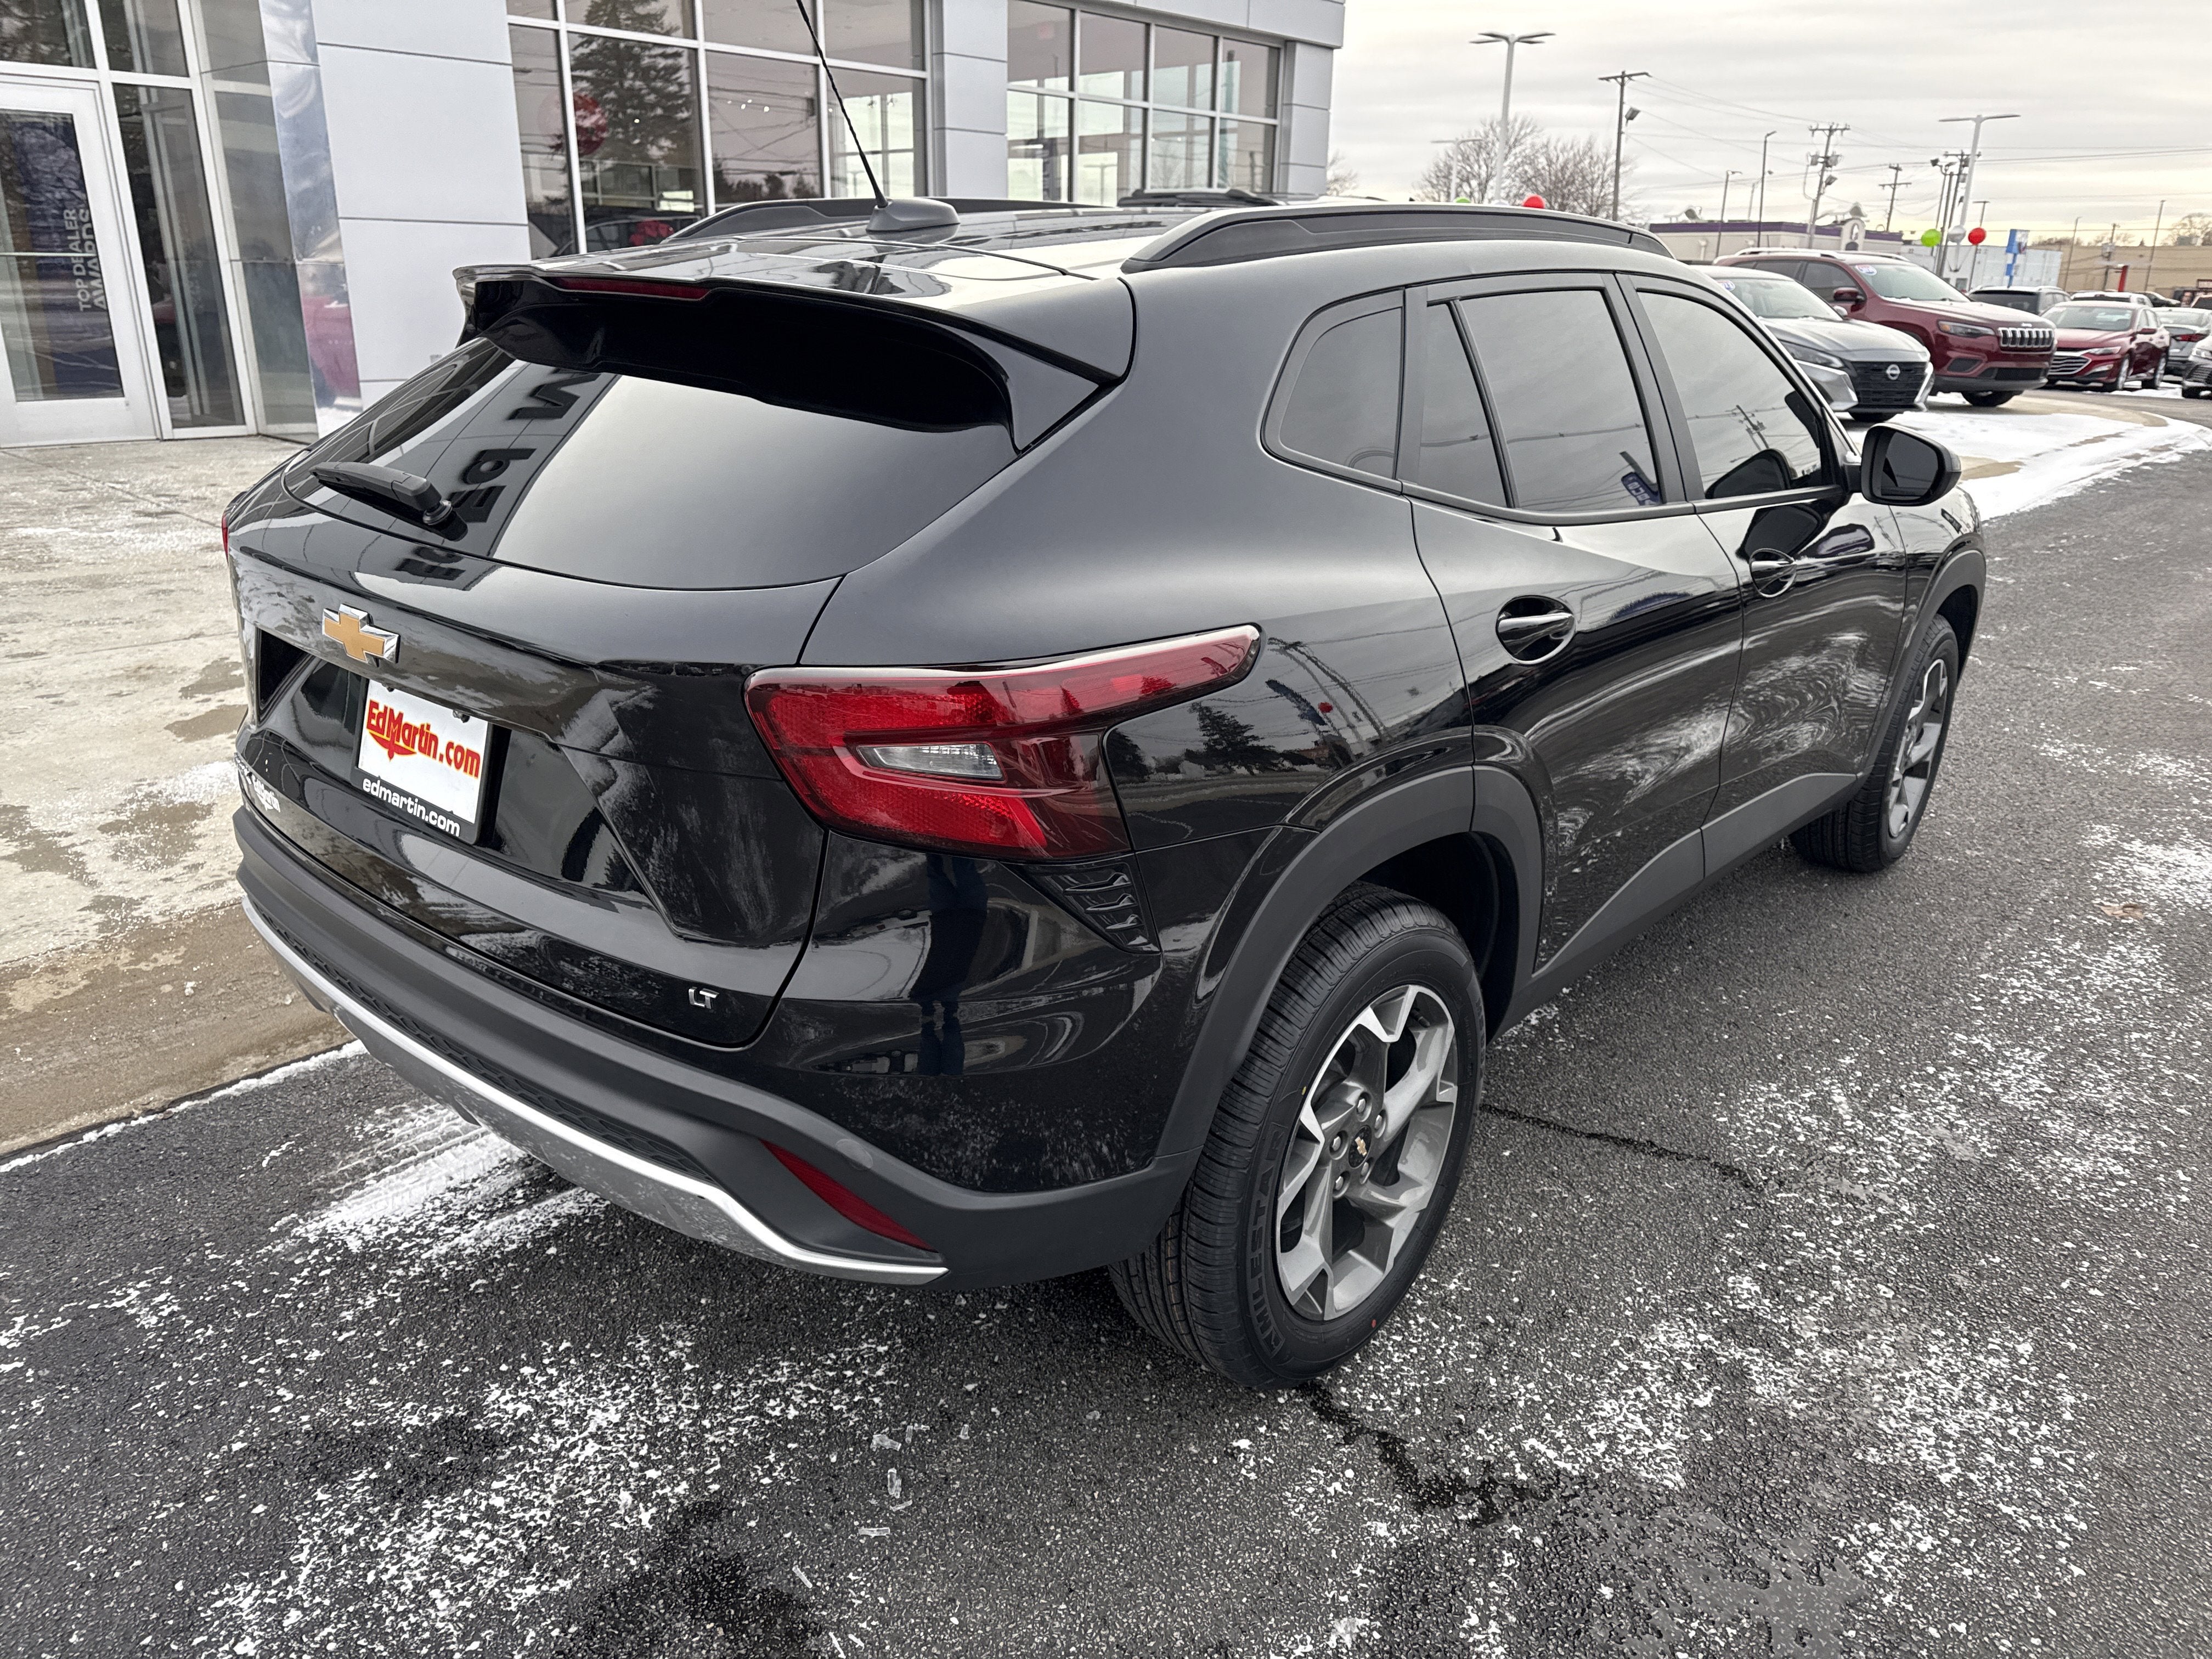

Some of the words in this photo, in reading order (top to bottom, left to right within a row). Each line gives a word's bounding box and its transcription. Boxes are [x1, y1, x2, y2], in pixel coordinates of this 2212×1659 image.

[63, 208, 86, 276] DEALER
[75, 278, 92, 312] TOP
[366, 698, 481, 779] EdMartin.com
[363, 777, 460, 837] edmartin.com
[688, 986, 720, 1009] LT
[1250, 1126, 1284, 1335] MILESTAR
